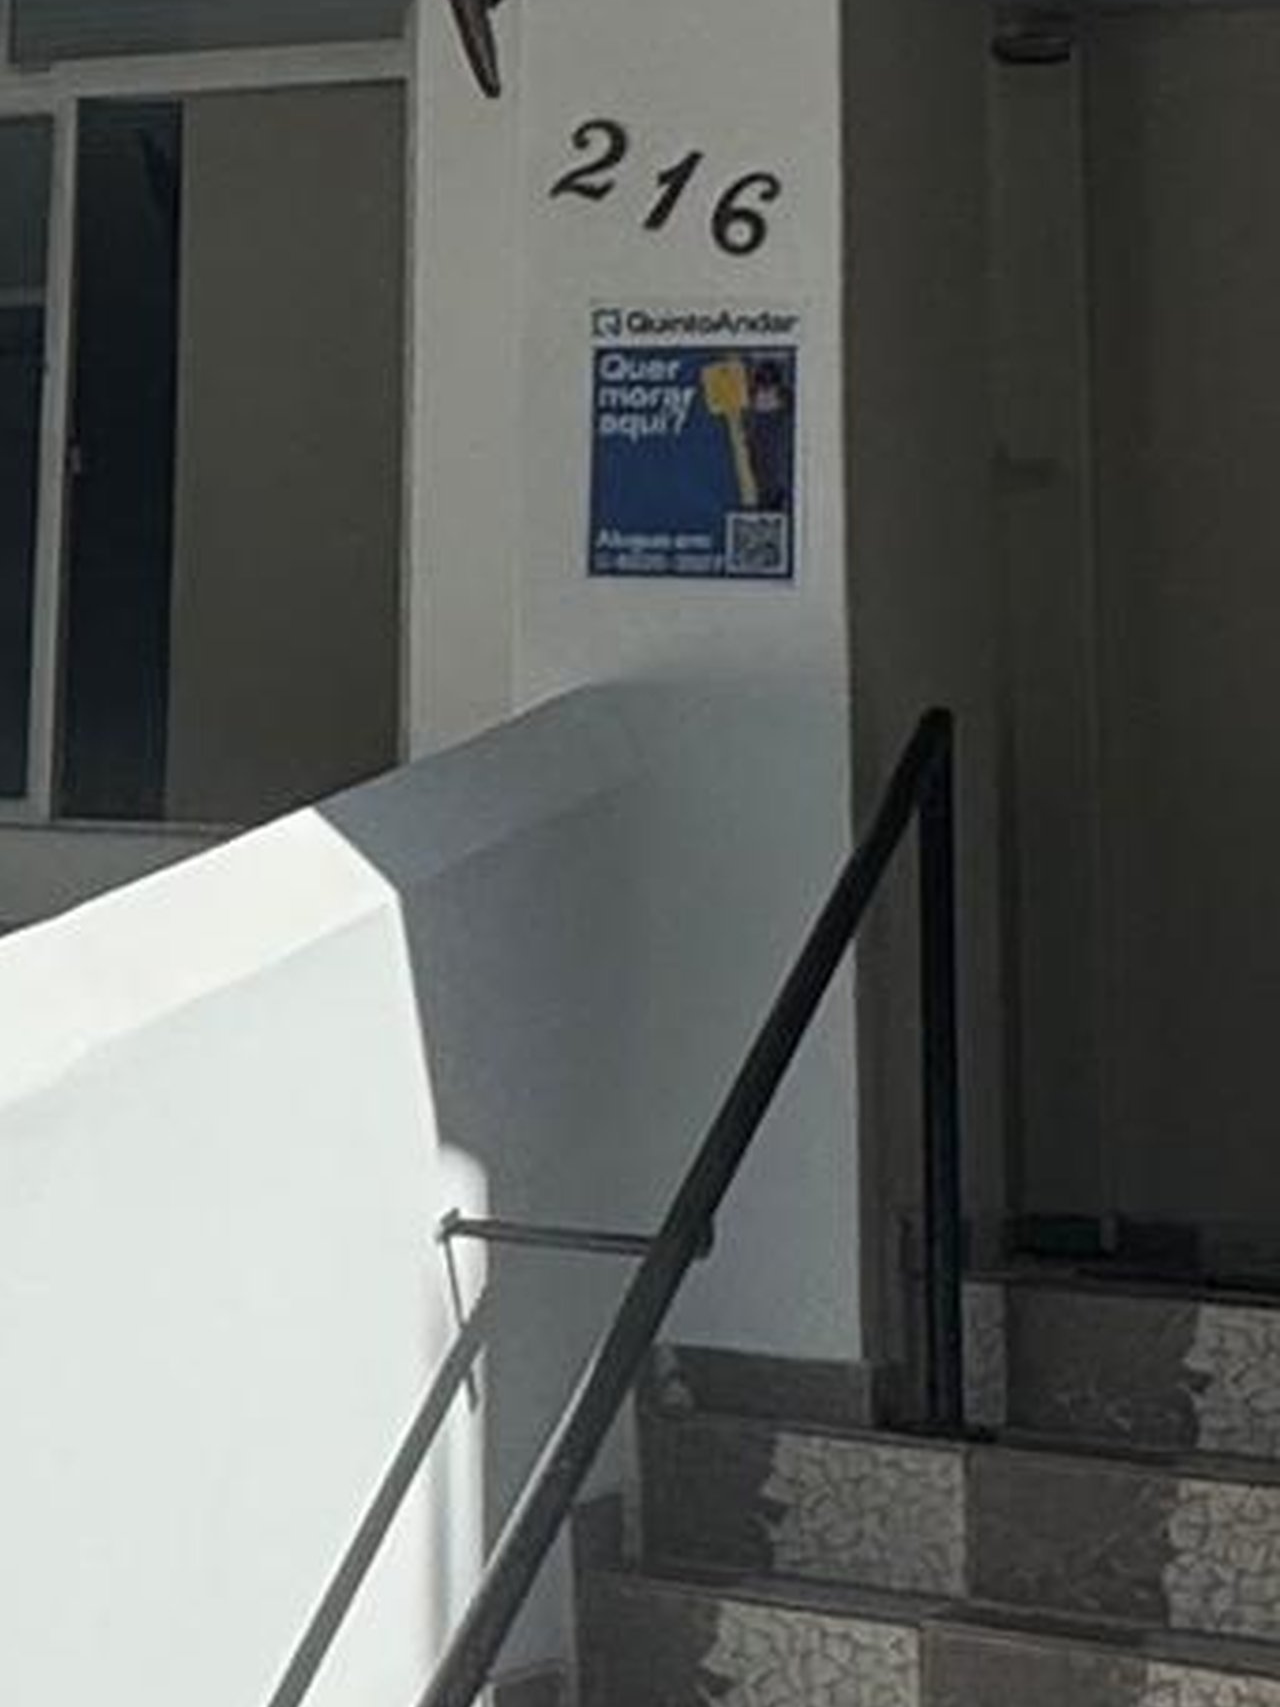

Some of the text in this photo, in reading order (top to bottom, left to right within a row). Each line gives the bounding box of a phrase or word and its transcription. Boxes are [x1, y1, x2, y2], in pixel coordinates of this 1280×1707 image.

[551, 119, 782, 255] 216
[626, 310, 799, 335] QuintoAndar
[599, 354, 680, 381] Quer
[599, 386, 695, 409] morar
